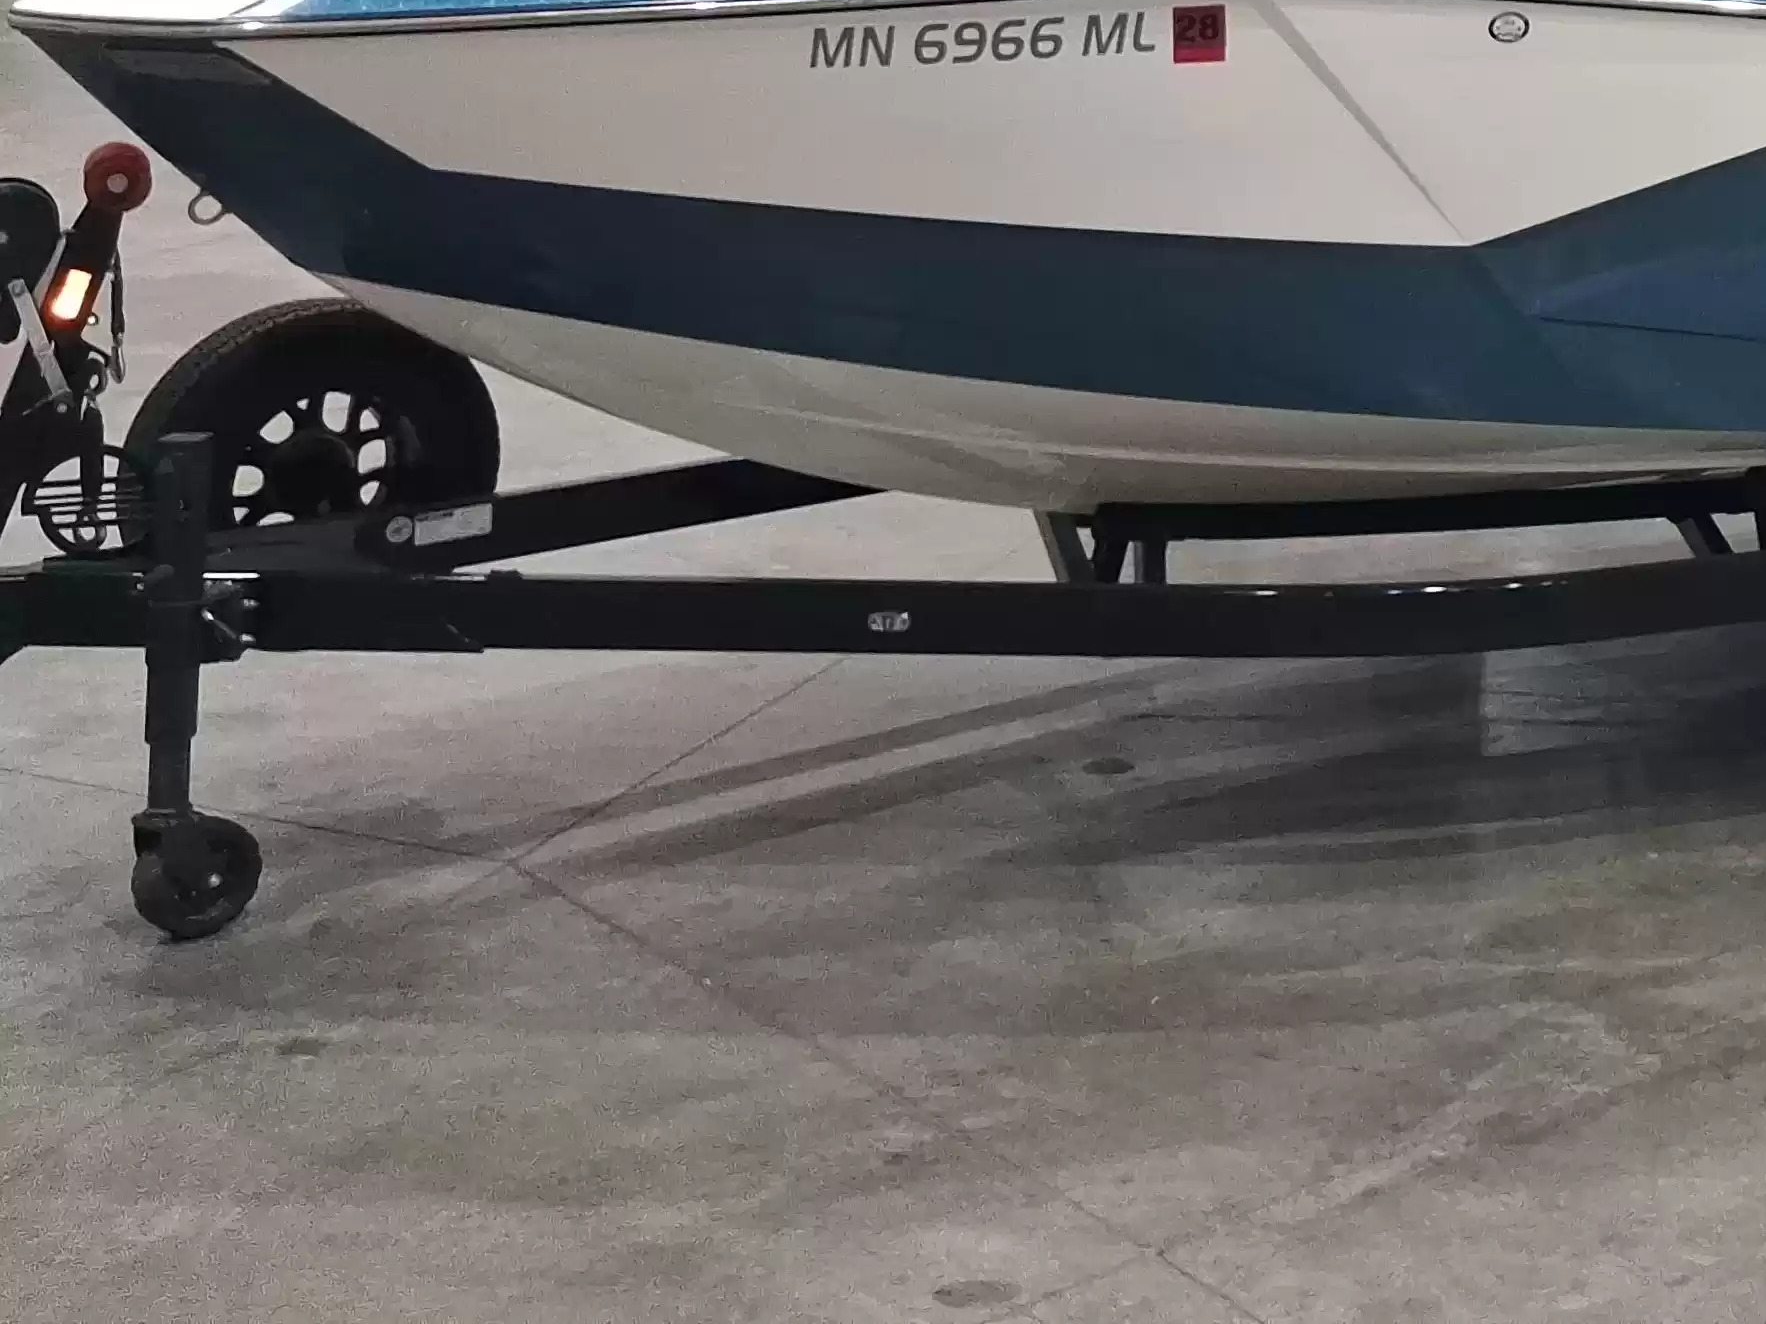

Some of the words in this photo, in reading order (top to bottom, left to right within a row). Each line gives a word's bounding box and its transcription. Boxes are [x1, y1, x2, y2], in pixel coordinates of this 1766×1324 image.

[809, 25, 896, 69] MN
[913, 16, 1065, 65] 6966
[1081, 11, 1156, 57] ML
[1175, 14, 1219, 42] 28
